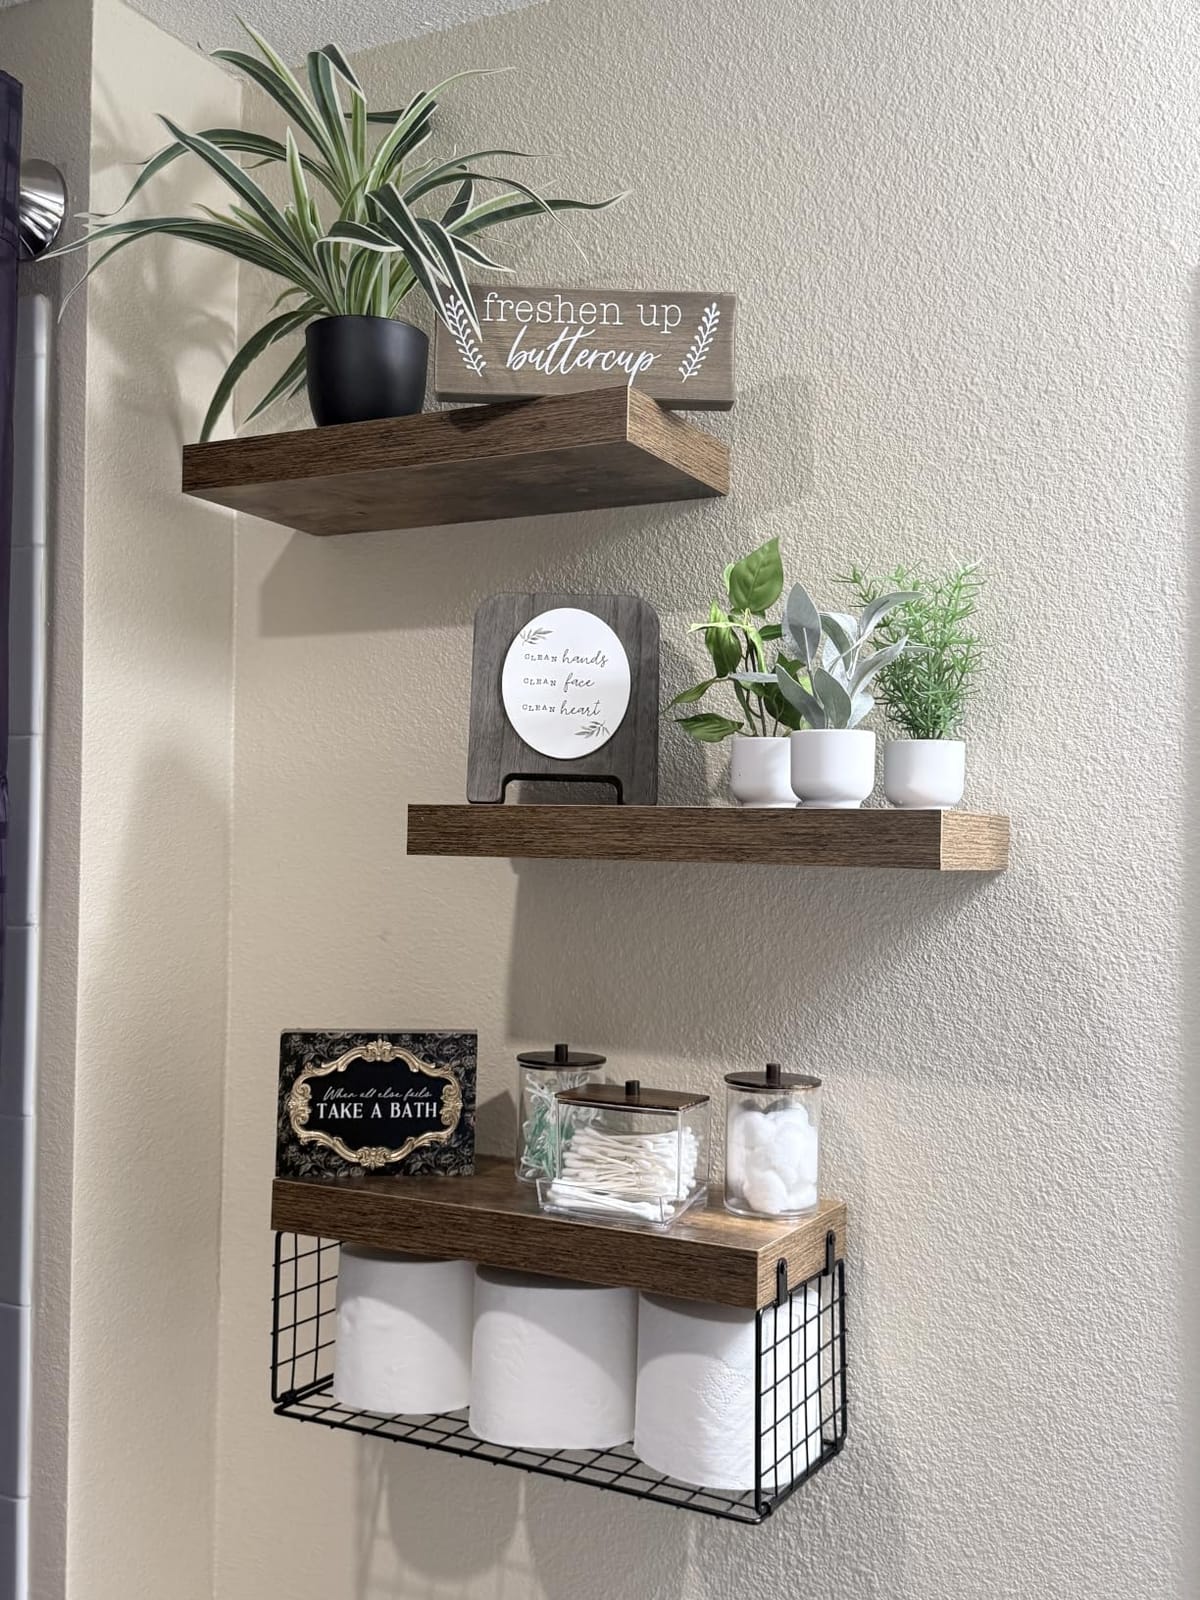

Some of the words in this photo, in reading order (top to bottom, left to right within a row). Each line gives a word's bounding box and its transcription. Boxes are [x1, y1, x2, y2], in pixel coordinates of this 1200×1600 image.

[482, 291, 624, 325] freshen
[636, 303, 682, 334] up
[506, 325, 662, 387] buttercup
[524, 653, 558, 663] CLEAN
[562, 648, 608, 668] hands
[523, 677, 557, 687] CLEAN
[563, 672, 595, 693] face
[522, 704, 556, 713] CLEAN
[560, 699, 601, 716] heart
[323, 1086, 357, 1101] When
[360, 1087, 376, 1098] all
[377, 1087, 403, 1098] else
[403, 1087, 433, 1101] fails
[316, 1102, 364, 1119] TAKE
[371, 1102, 383, 1119] A
[390, 1102, 438, 1119] BATH
